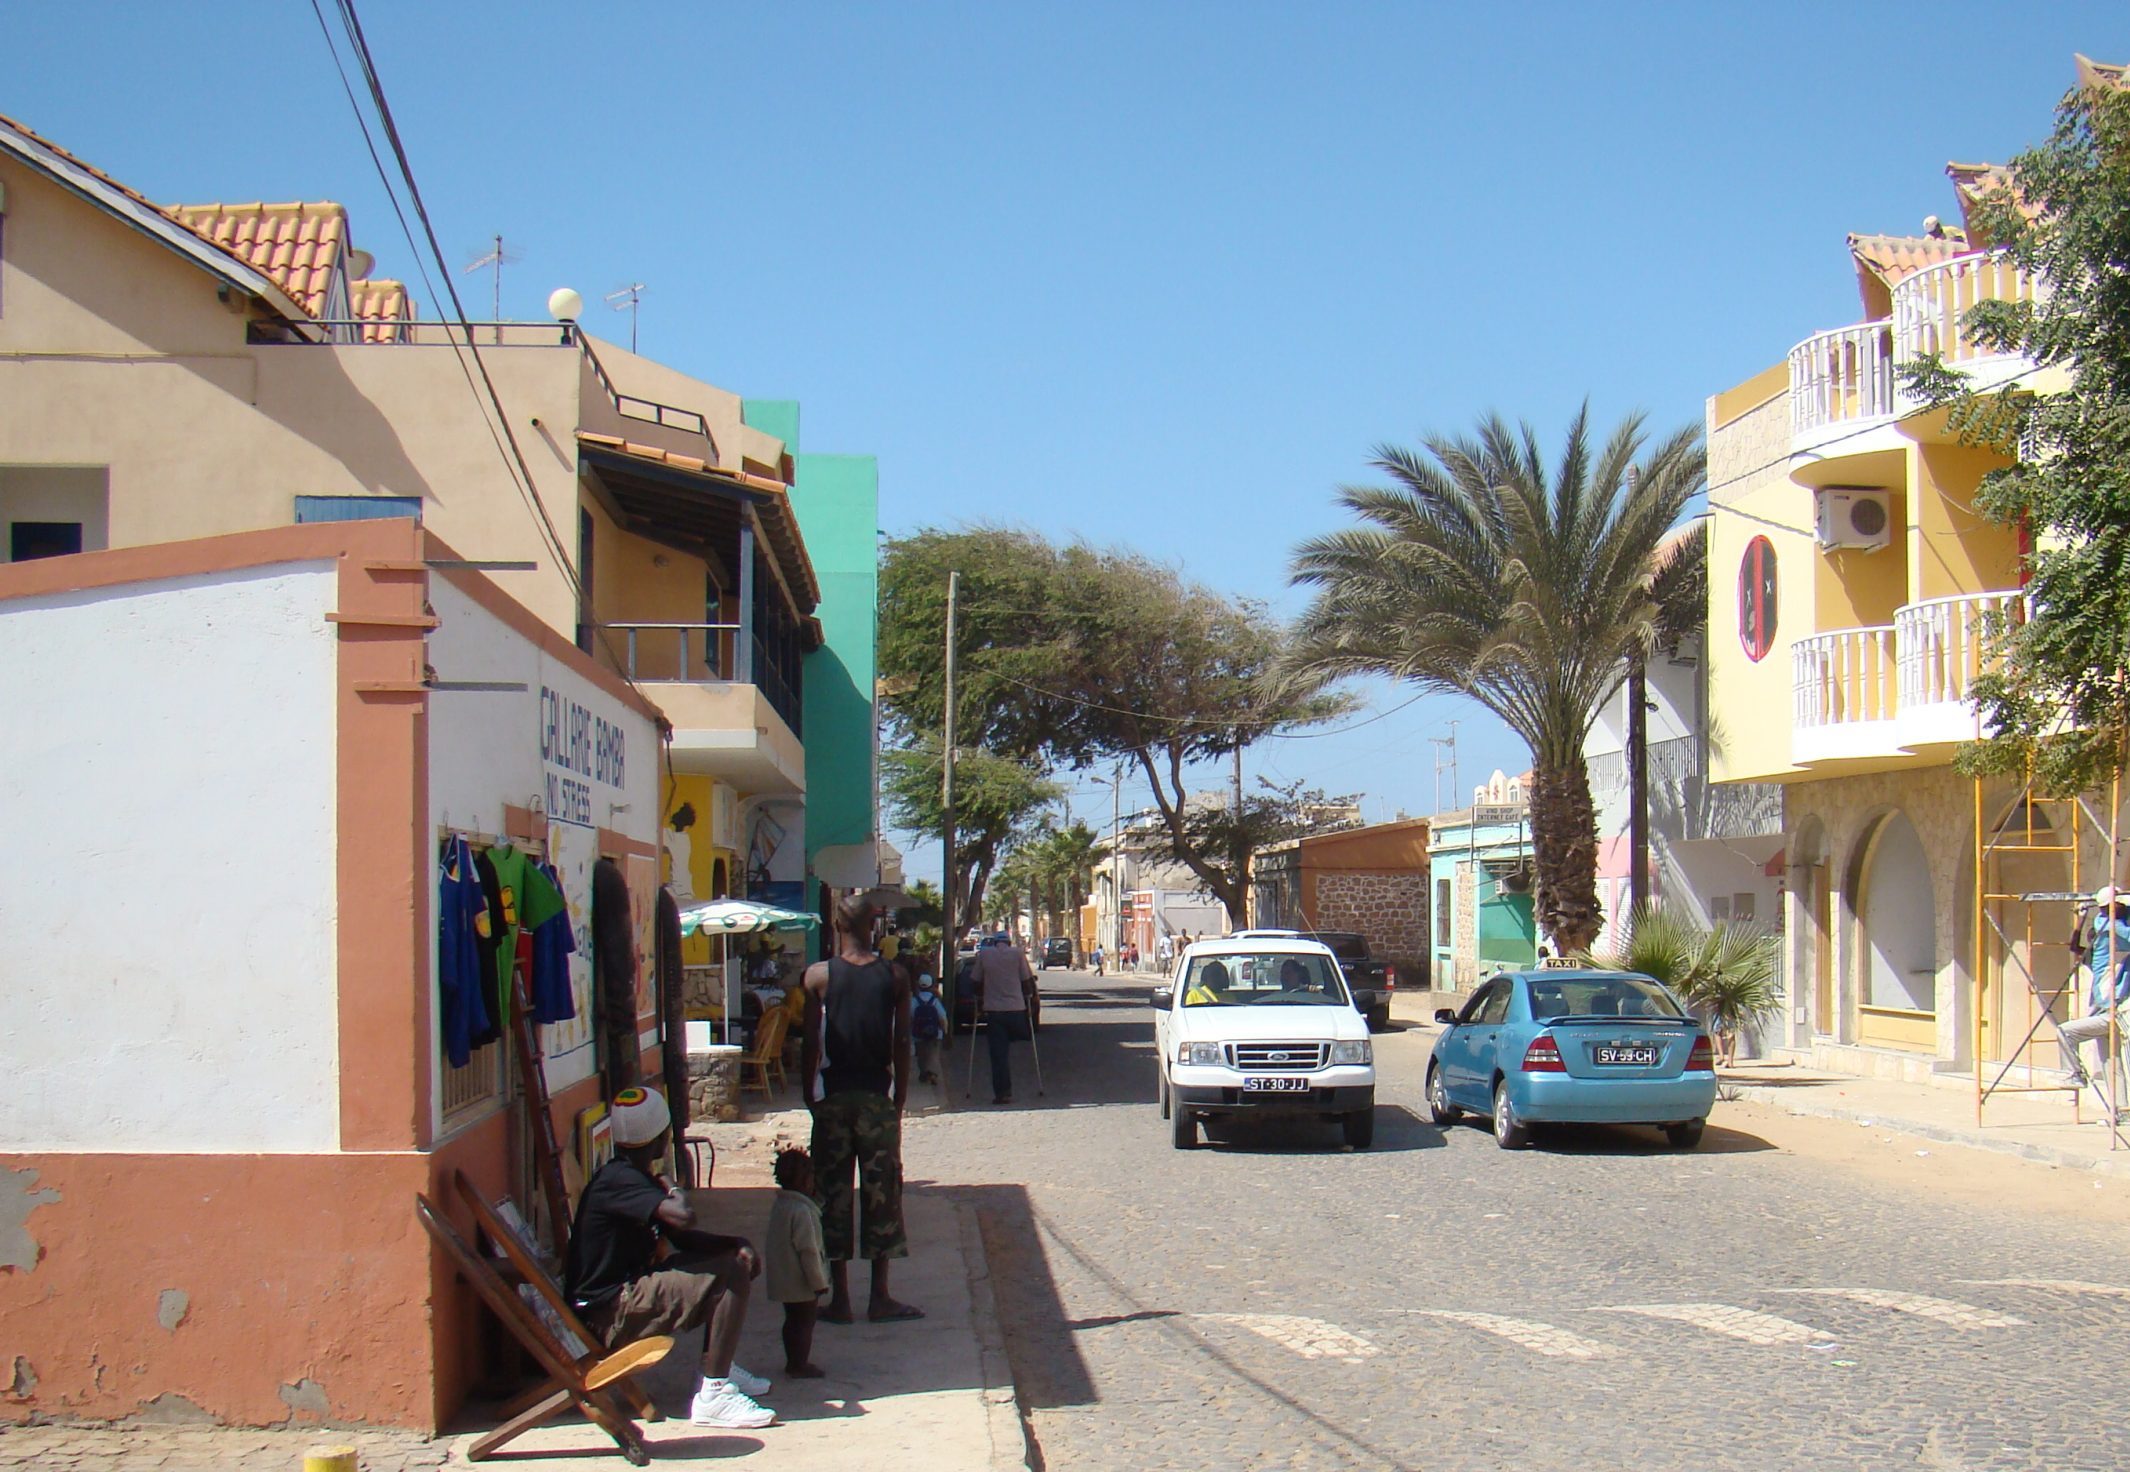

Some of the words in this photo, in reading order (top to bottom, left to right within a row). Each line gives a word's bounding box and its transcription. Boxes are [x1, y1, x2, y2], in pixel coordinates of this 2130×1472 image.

[546, 771, 559, 816] NO
[563, 778, 591, 823] STRESS
[1548, 959, 1576, 969] TAXI
